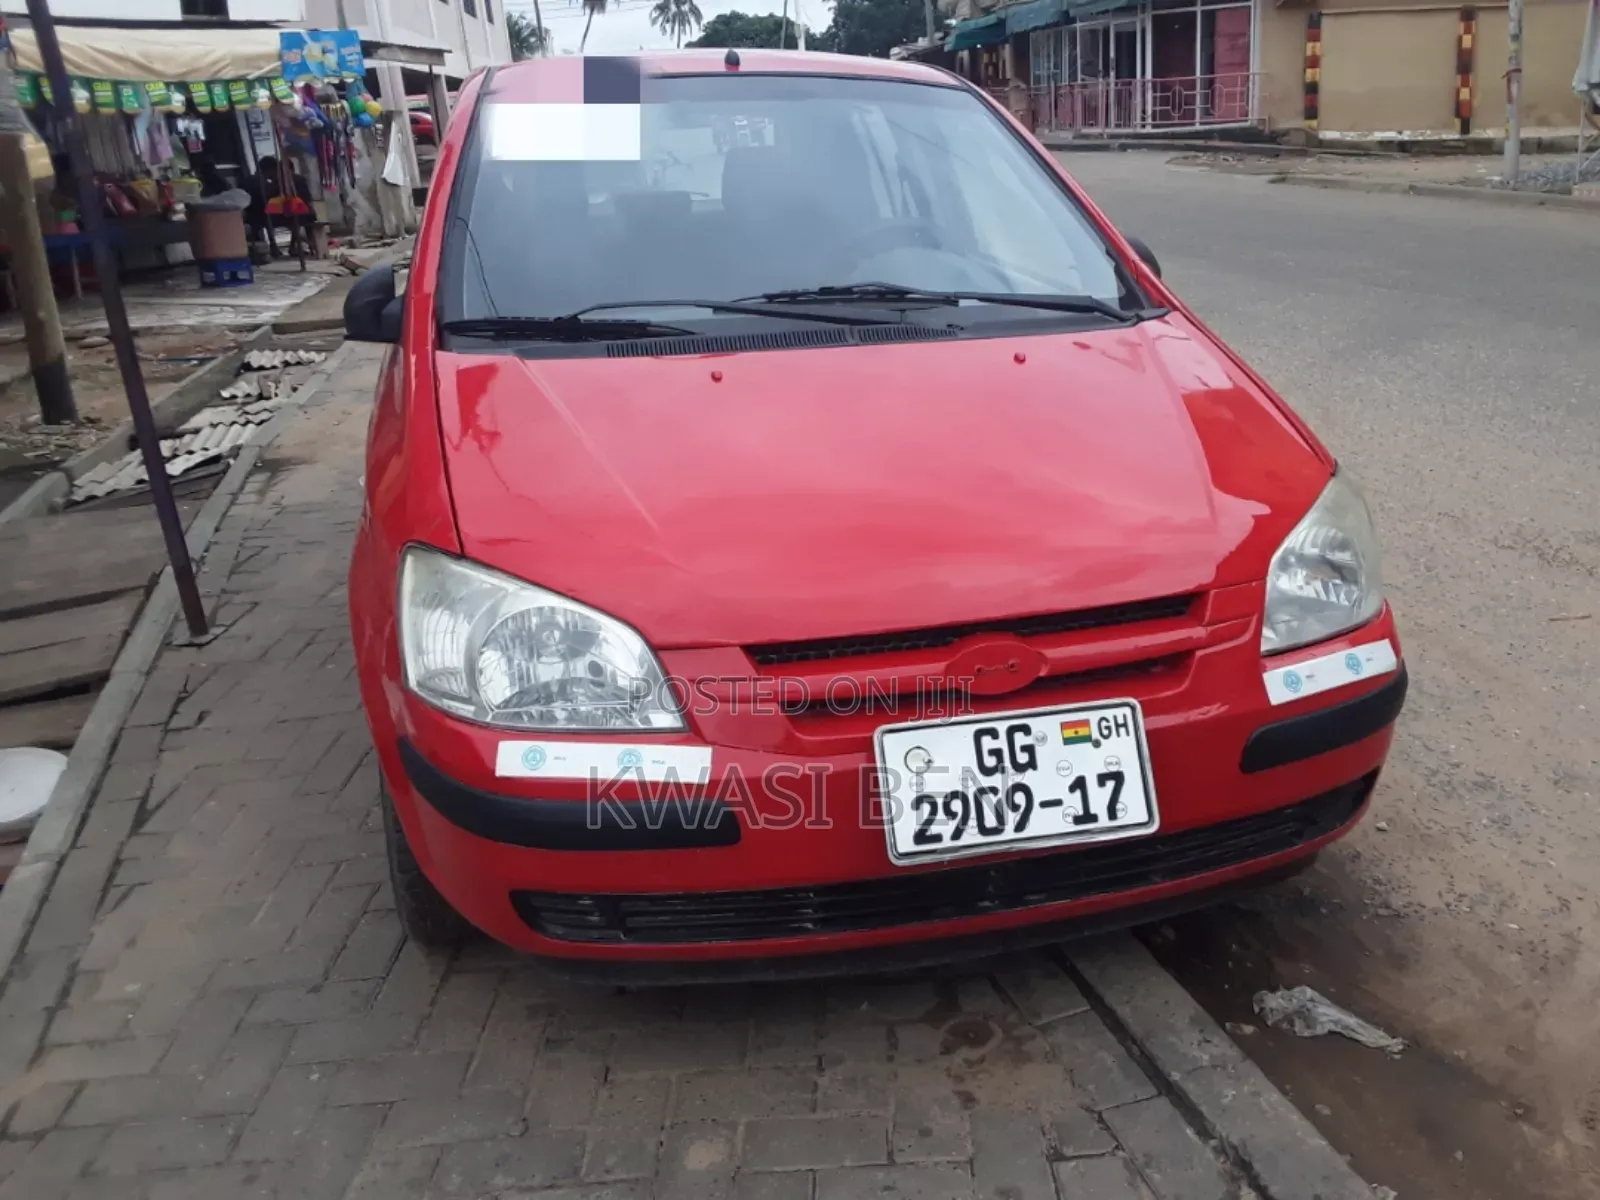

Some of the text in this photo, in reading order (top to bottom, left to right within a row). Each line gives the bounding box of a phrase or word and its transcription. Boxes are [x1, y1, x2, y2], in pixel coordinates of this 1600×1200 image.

[973, 723, 1038, 777] GG
[1097, 713, 1131, 740] GH
[910, 770, 1126, 846] 2909-17
